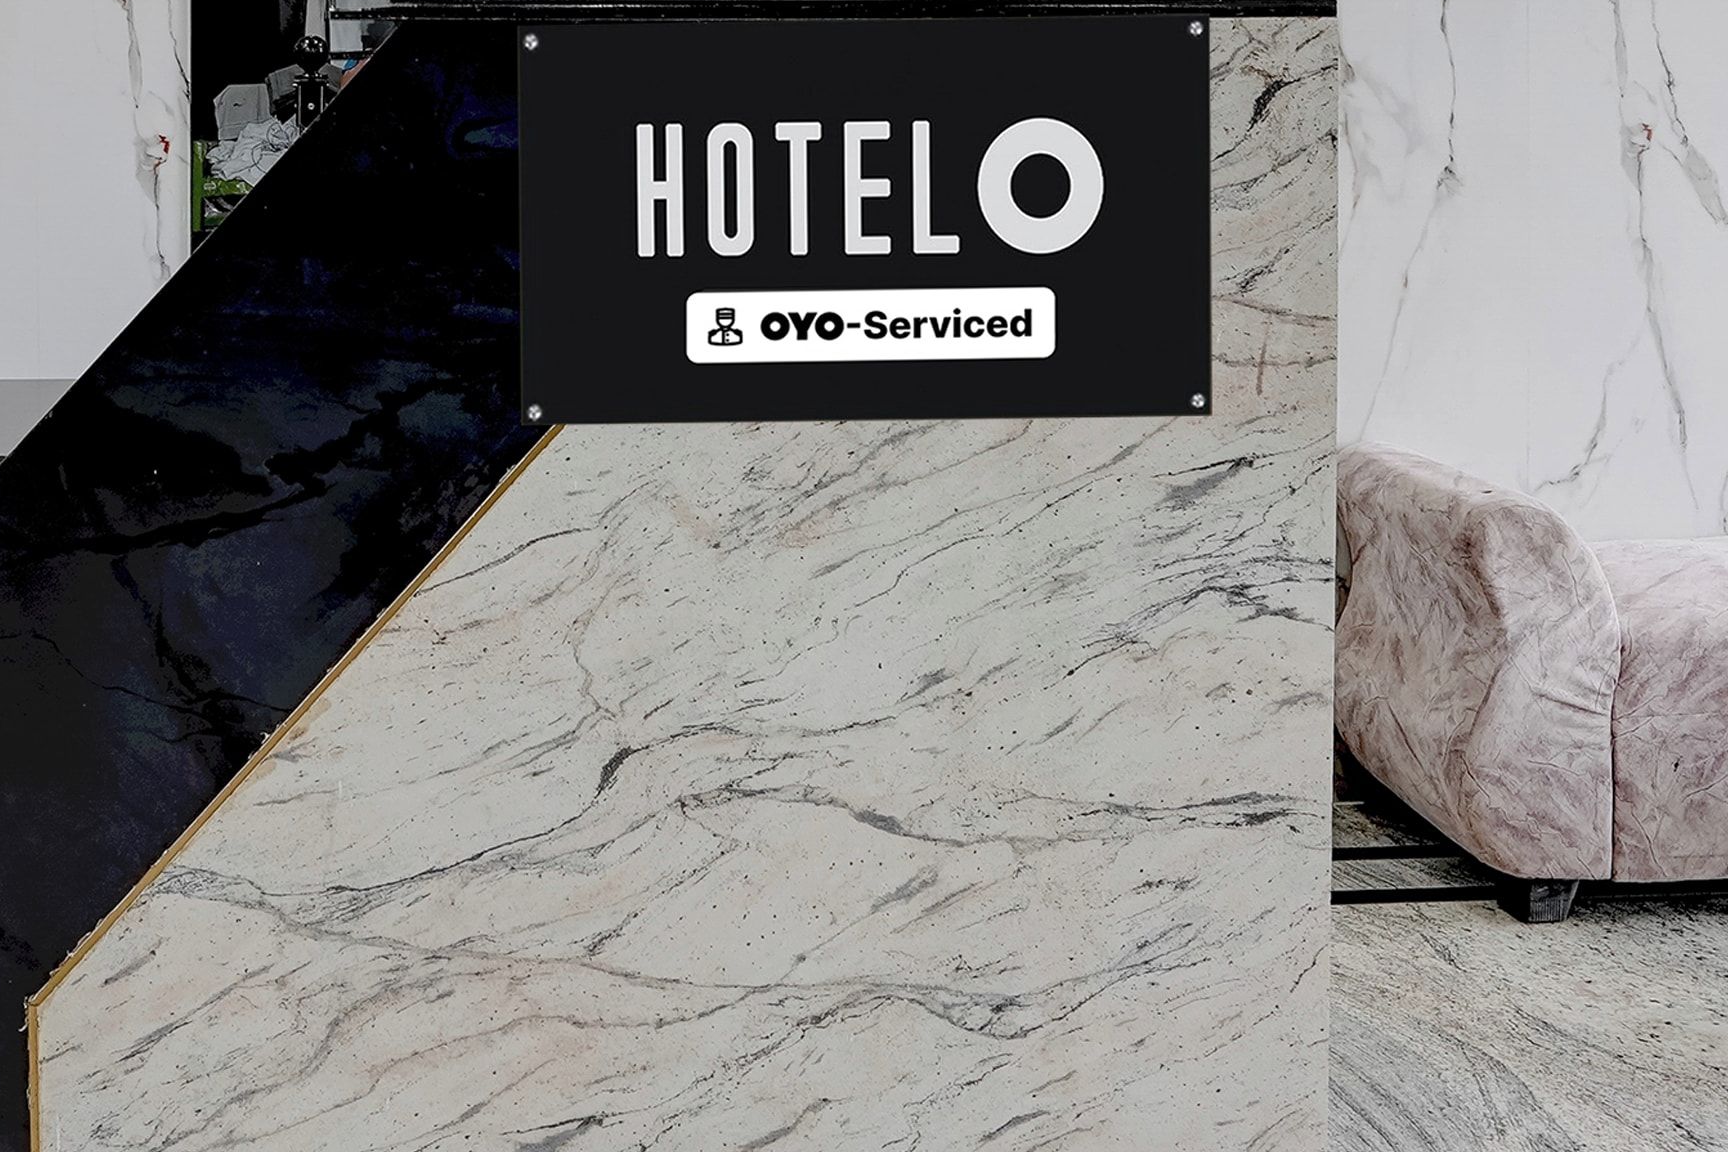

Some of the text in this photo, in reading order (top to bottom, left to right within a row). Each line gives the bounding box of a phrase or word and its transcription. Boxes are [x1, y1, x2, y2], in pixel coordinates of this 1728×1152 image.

[636, 117, 1104, 258] HOTEL O
[760, 307, 1033, 341] OYO-Serviced
